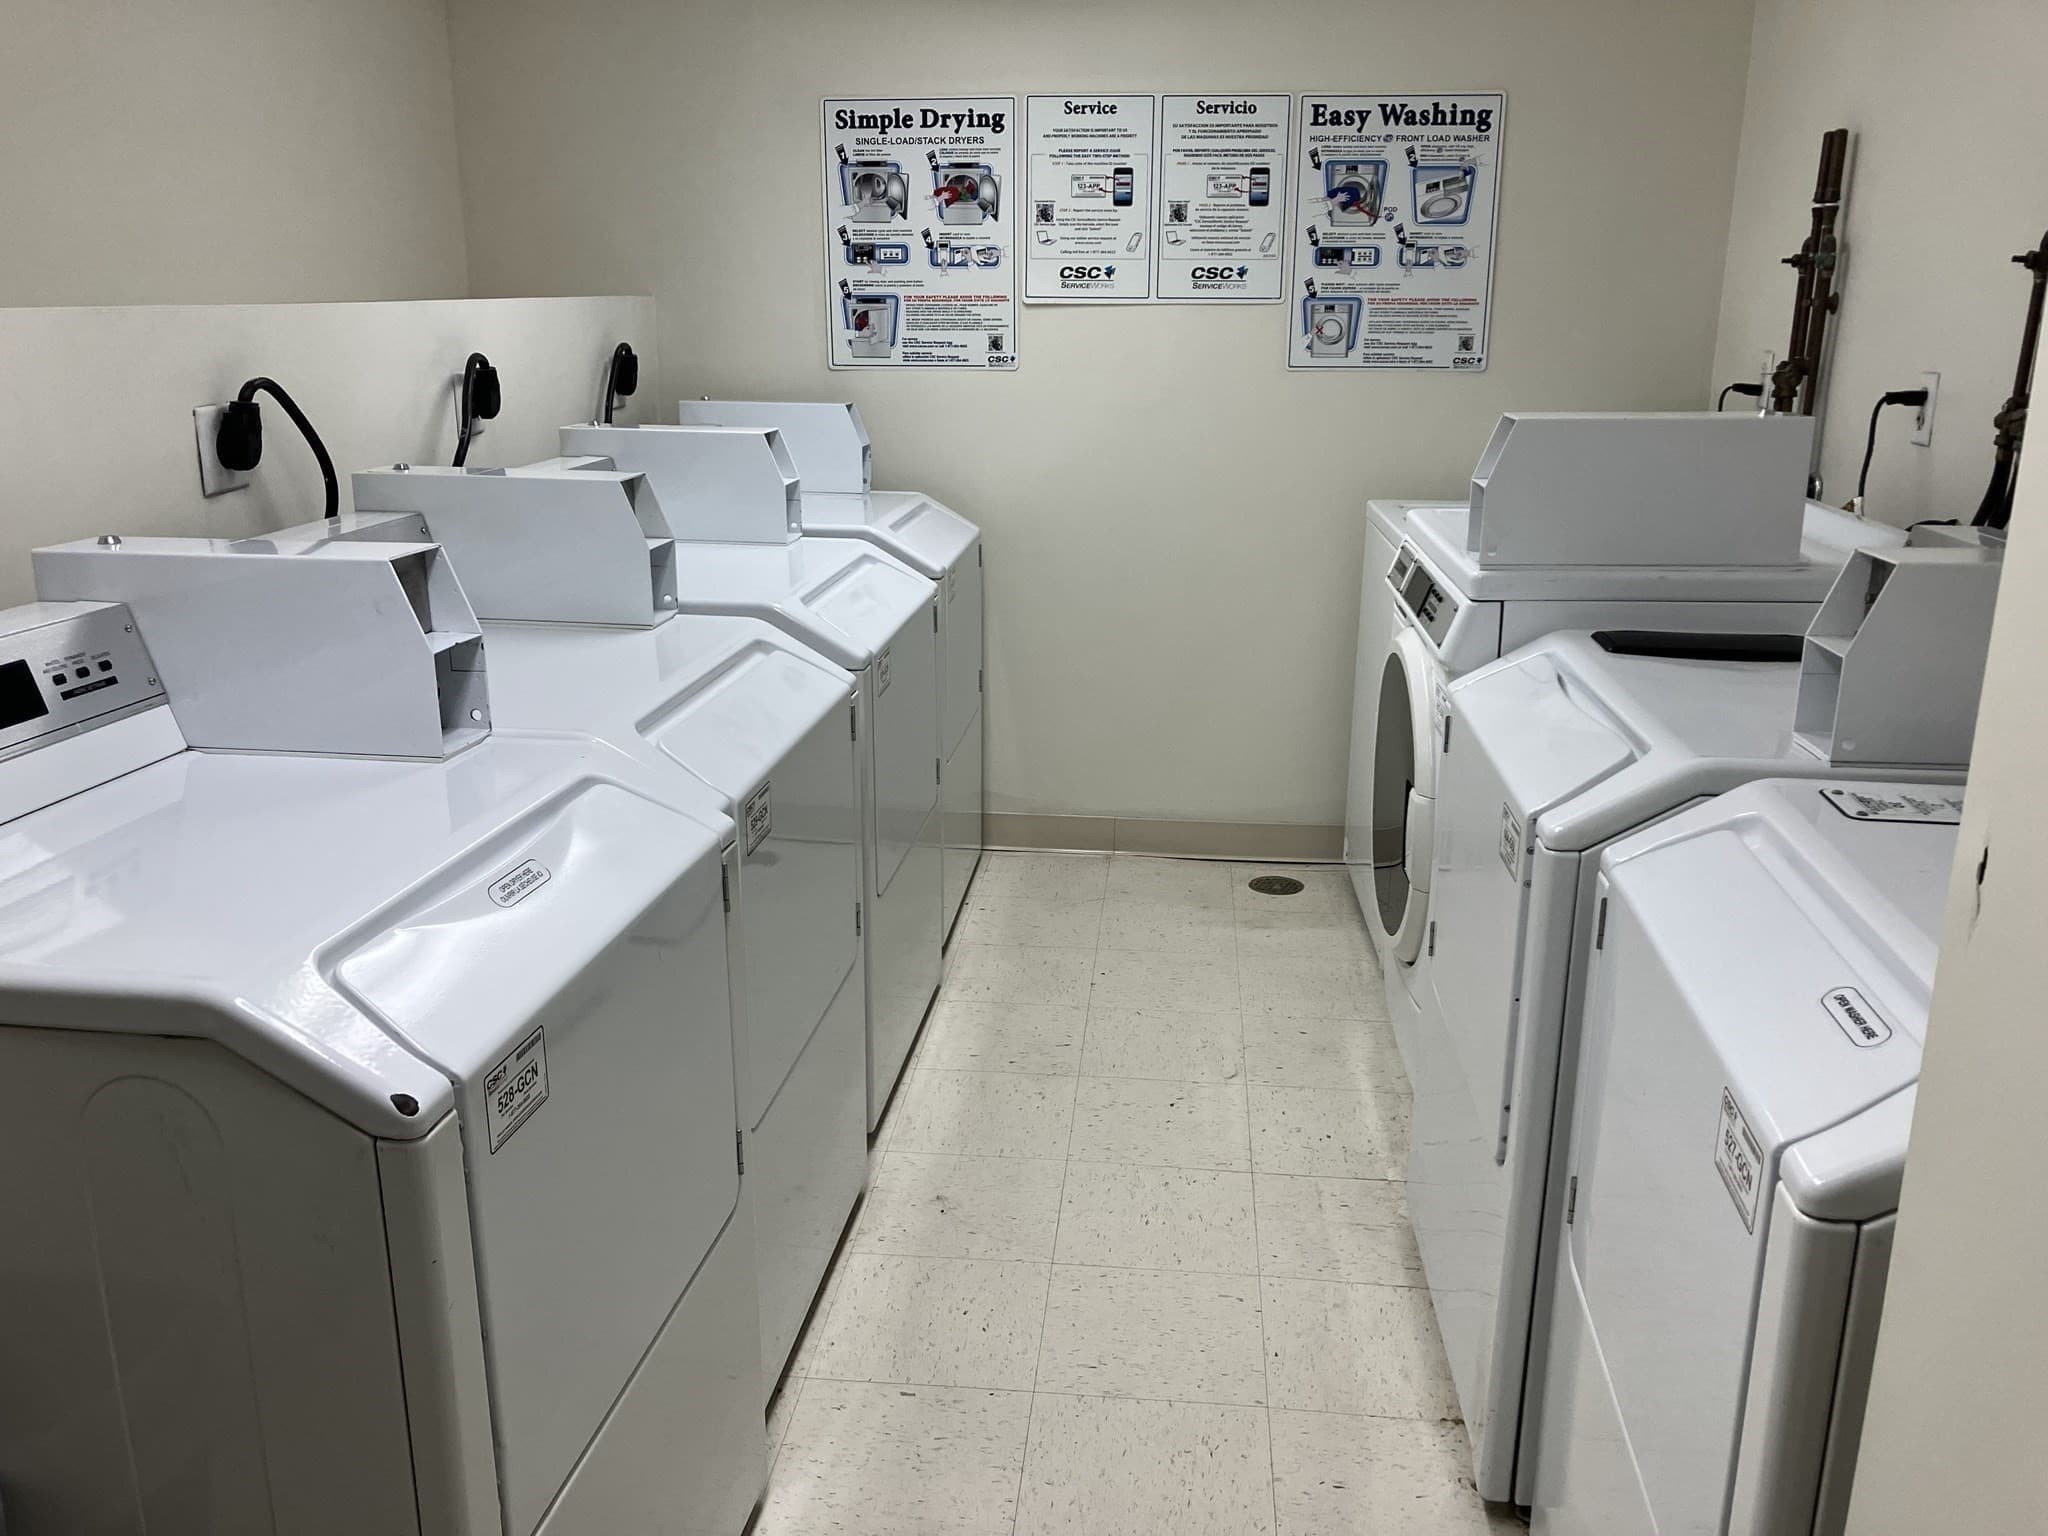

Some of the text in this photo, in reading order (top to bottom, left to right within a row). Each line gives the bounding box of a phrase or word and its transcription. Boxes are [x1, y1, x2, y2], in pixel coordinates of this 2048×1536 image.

[1064, 101, 1117, 114] Service
[1196, 100, 1257, 114] Servicio
[835, 108, 1005, 134] Simple Drying
[1310, 102, 1493, 133] Easy Washing
[855, 136, 985, 145] SINGLE-LOAD/STACK DRYERS
[1060, 266, 1101, 279] CSC
[1191, 267, 1234, 279] CSC
[988, 355, 1009, 363] CSC
[498, 1062, 538, 1113] 528-GCN
[1724, 1129, 1752, 1191] 527-GCN
